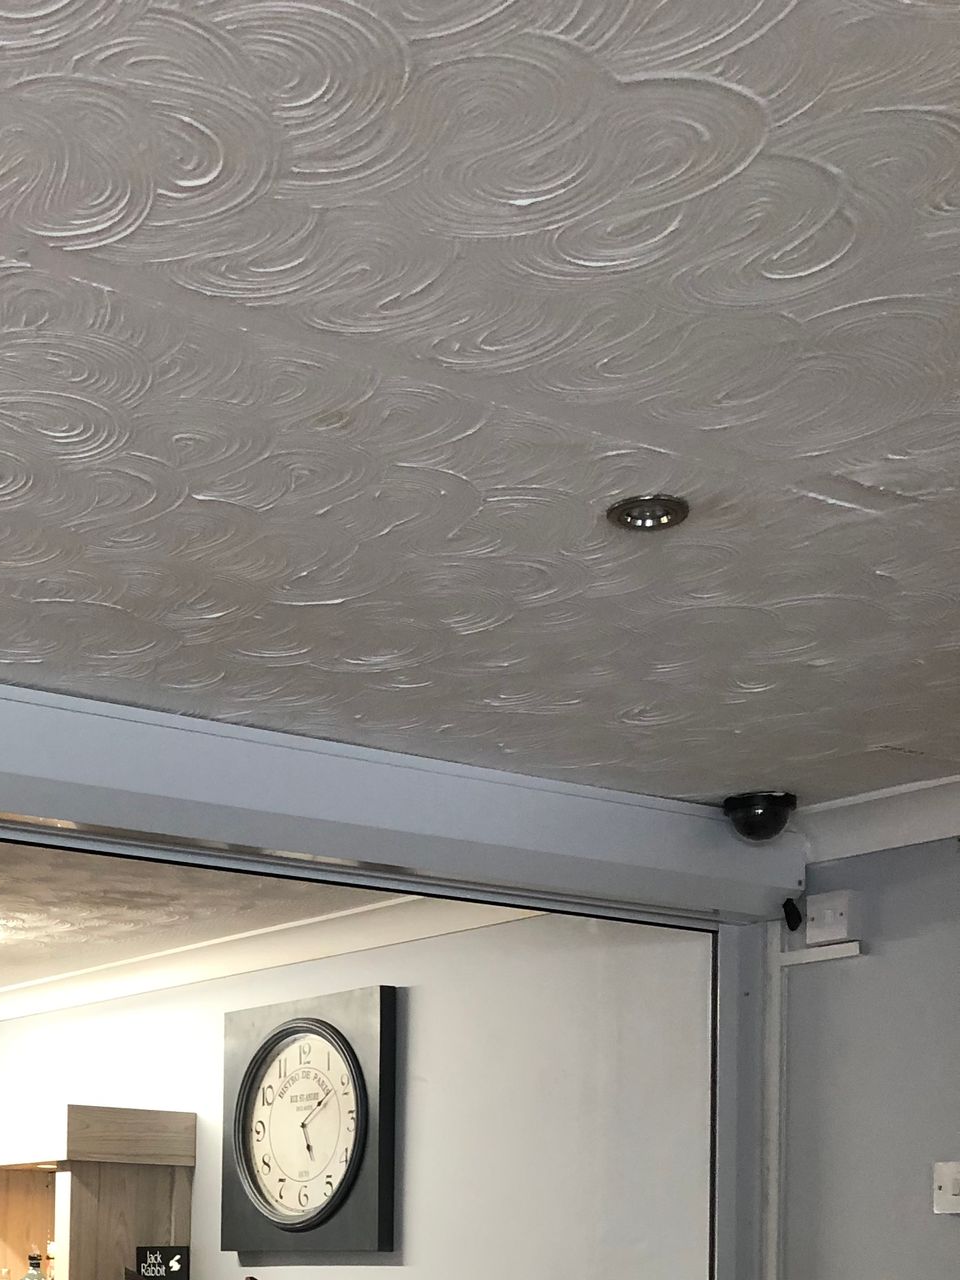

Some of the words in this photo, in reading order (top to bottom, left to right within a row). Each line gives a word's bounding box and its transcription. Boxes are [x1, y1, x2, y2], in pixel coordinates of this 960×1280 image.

[299, 1042, 311, 1066] 12
[326, 1051, 331, 1071] 1
[278, 1058, 288, 1079] 11
[301, 1070, 312, 1080] DE
[262, 1084, 275, 1107] 10
[340, 1074, 351, 1096] 2
[254, 1120, 266, 1142] 9
[347, 1109, 356, 1133] 3
[261, 1153, 271, 1176] 8
[339, 1147, 349, 1168] 4
[278, 1178, 287, 1200] 7
[298, 1185, 309, 1208] 6
[323, 1174, 334, 1198] 5
[146, 1250, 163, 1265] Jack
[141, 1263, 167, 1277] Rabbit
